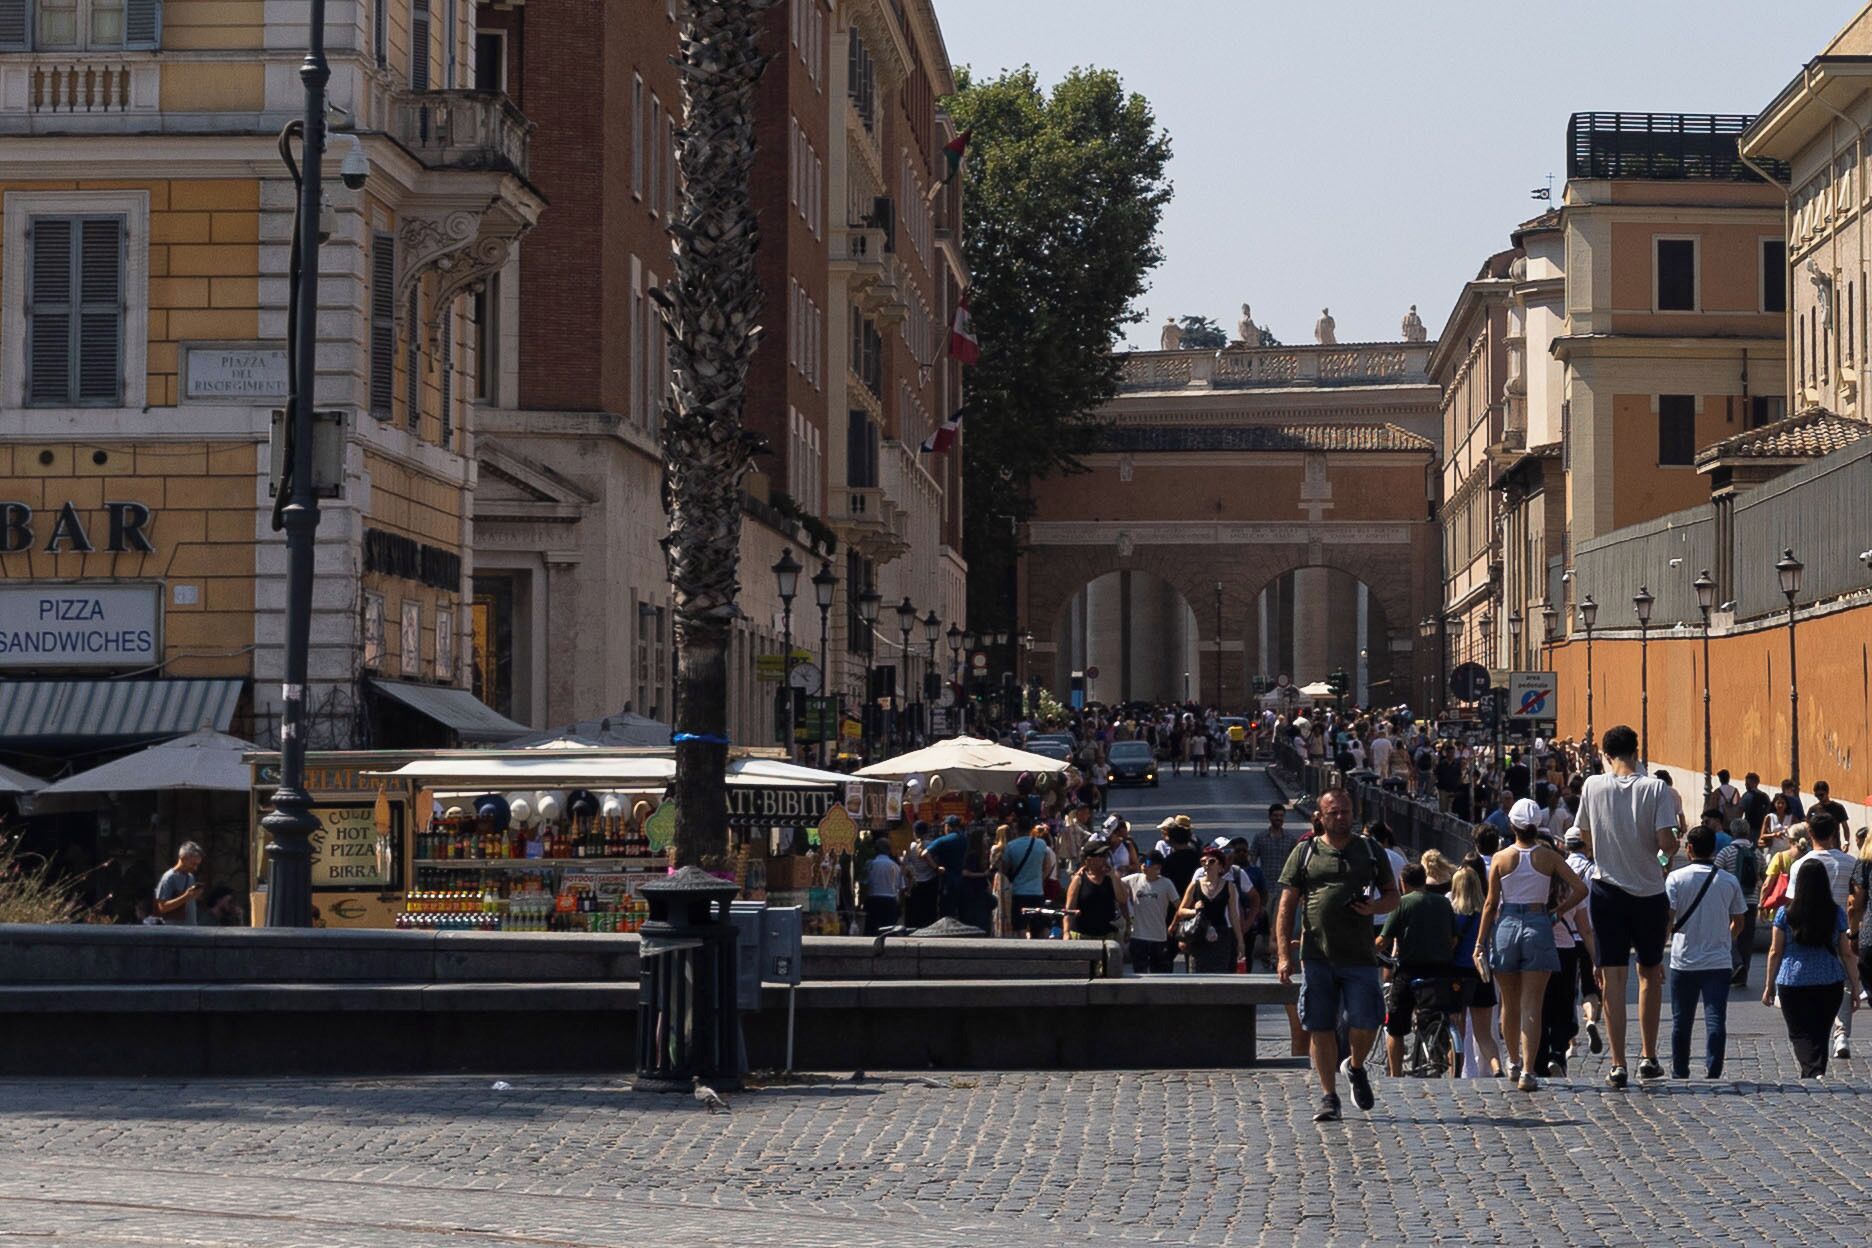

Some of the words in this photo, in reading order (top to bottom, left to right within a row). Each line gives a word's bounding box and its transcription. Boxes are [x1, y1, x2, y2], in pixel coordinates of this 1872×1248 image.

[221, 356, 266, 368] PIAZZA
[232, 369, 255, 379] DEL
[194, 380, 287, 392] RISORGIMENT
[0, 501, 156, 553] BAR
[39, 600, 105, 621] PIZZA
[0, 630, 151, 653] SANDWICHES
[762, 790, 834, 817] BIBITE
[336, 827, 370, 841] HOT
[331, 843, 376, 857] PIZZA
[329, 865, 378, 879] BIRRA
